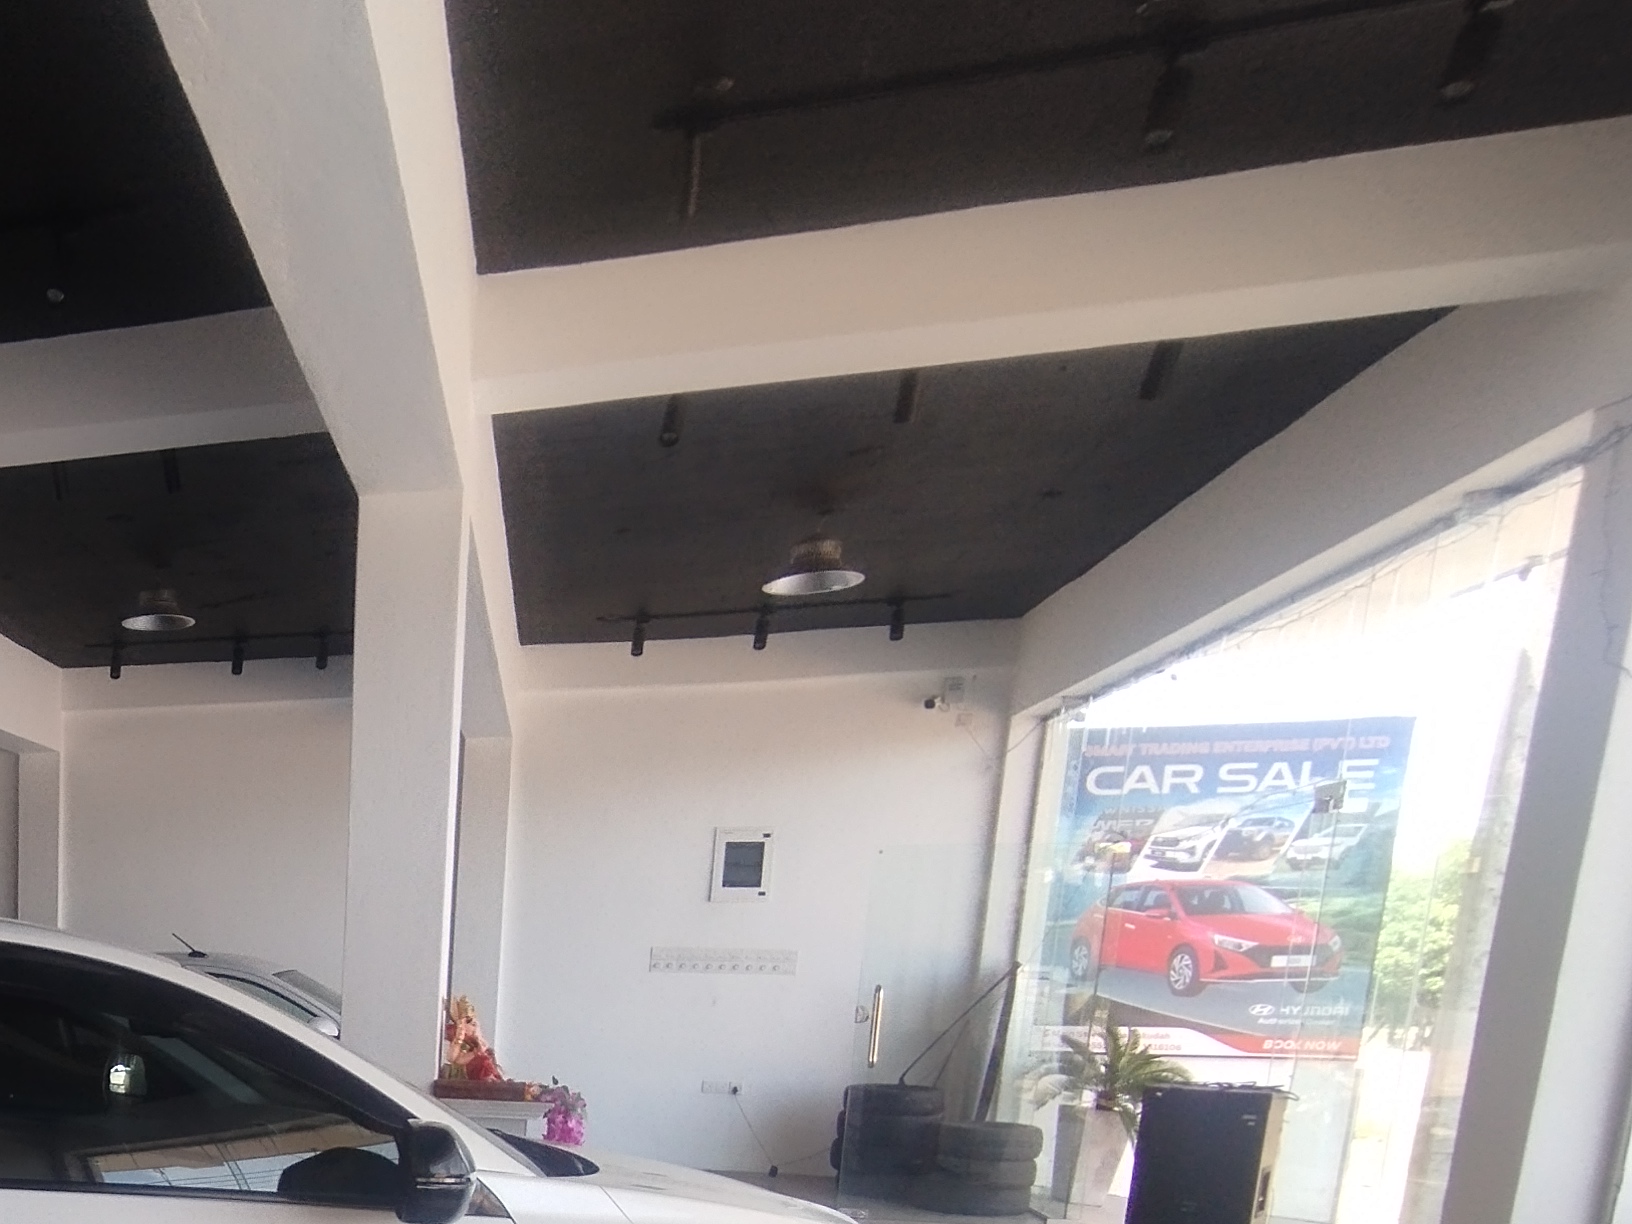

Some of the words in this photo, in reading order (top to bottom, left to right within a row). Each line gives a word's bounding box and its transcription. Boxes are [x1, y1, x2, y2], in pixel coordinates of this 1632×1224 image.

[1085, 763, 1204, 796] CAR
[1216, 758, 1380, 795] SALE
[1304, 1041, 1343, 1051] NOW
